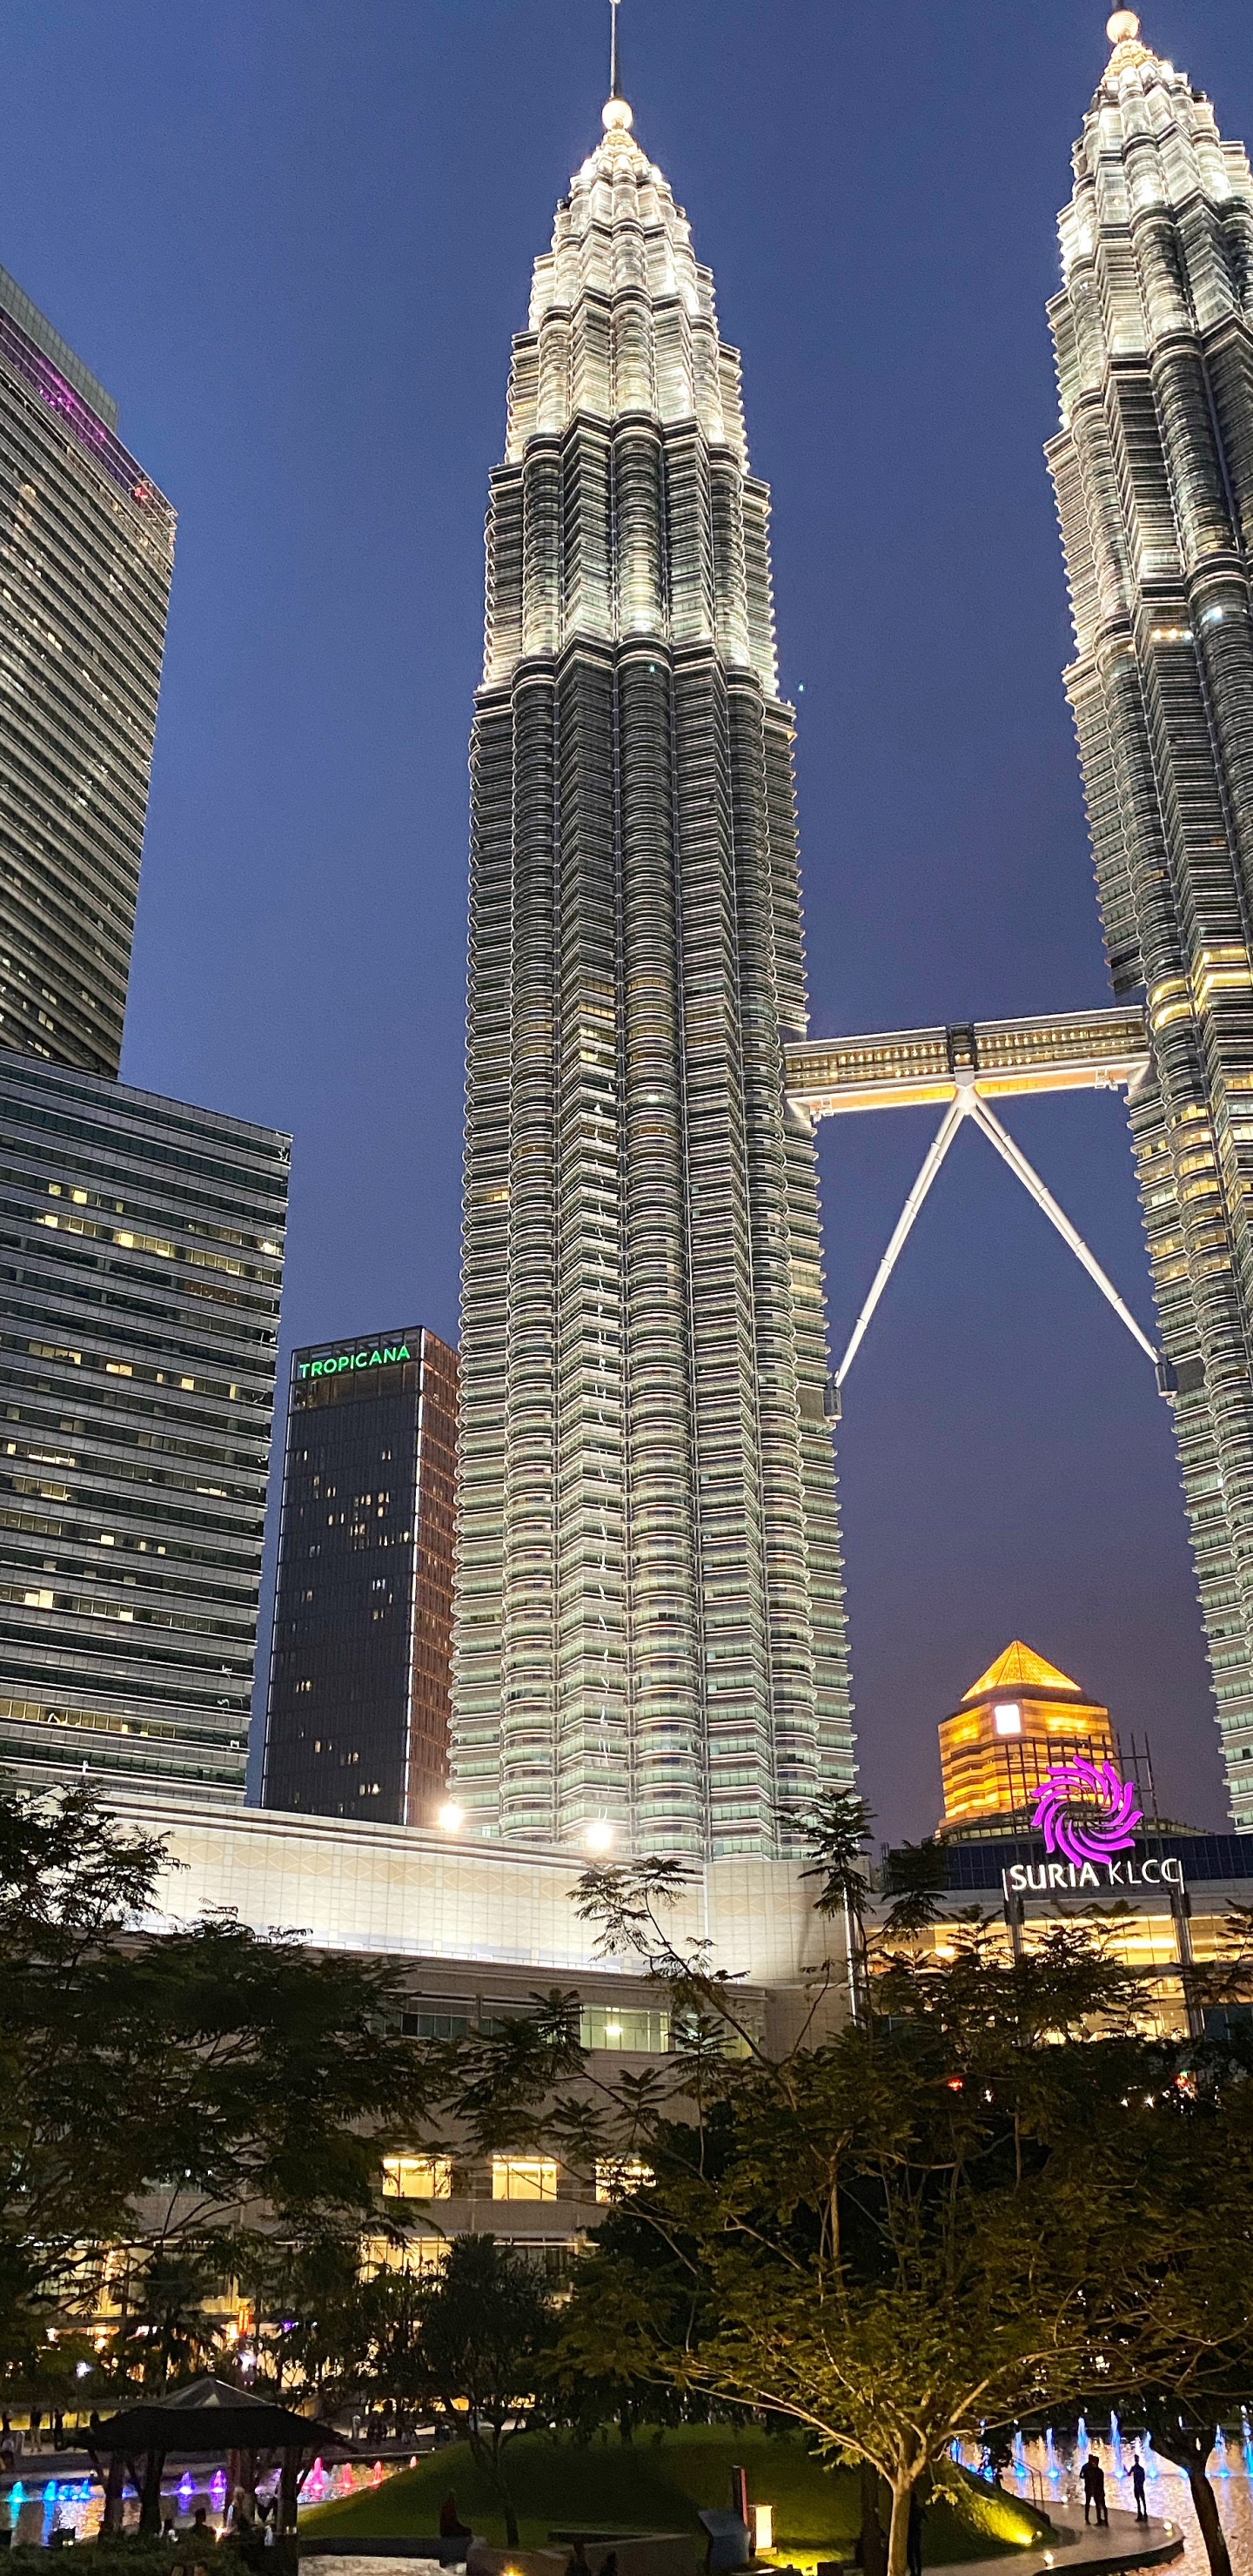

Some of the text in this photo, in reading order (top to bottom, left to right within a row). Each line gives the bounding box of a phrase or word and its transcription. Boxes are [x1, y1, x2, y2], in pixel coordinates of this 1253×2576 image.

[299, 1345, 411, 1379] TROPICANA
[1009, 1858, 1180, 1890] SURIA KLCC
